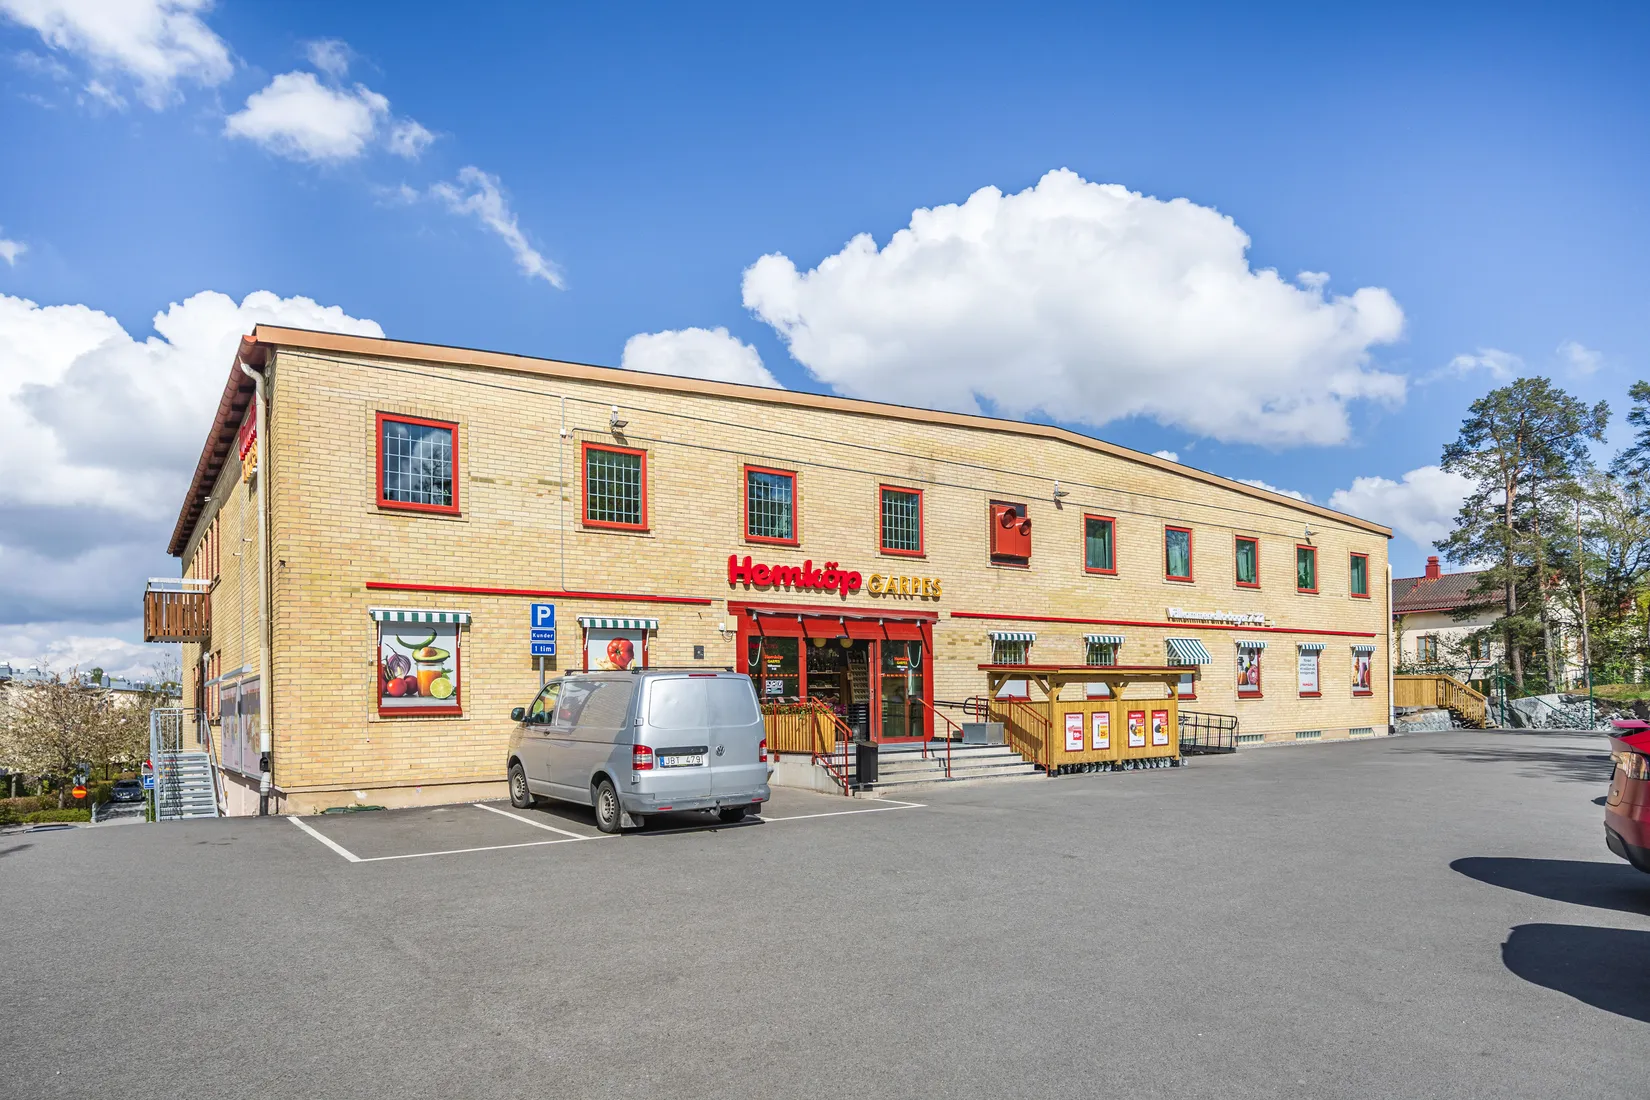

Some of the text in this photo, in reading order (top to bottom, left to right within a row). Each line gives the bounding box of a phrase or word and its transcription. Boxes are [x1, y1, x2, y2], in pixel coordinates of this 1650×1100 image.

[727, 554, 943, 597] Hemköp GARPES
[537, 606, 551, 626] P
[665, 755, 701, 765] JBT 479
